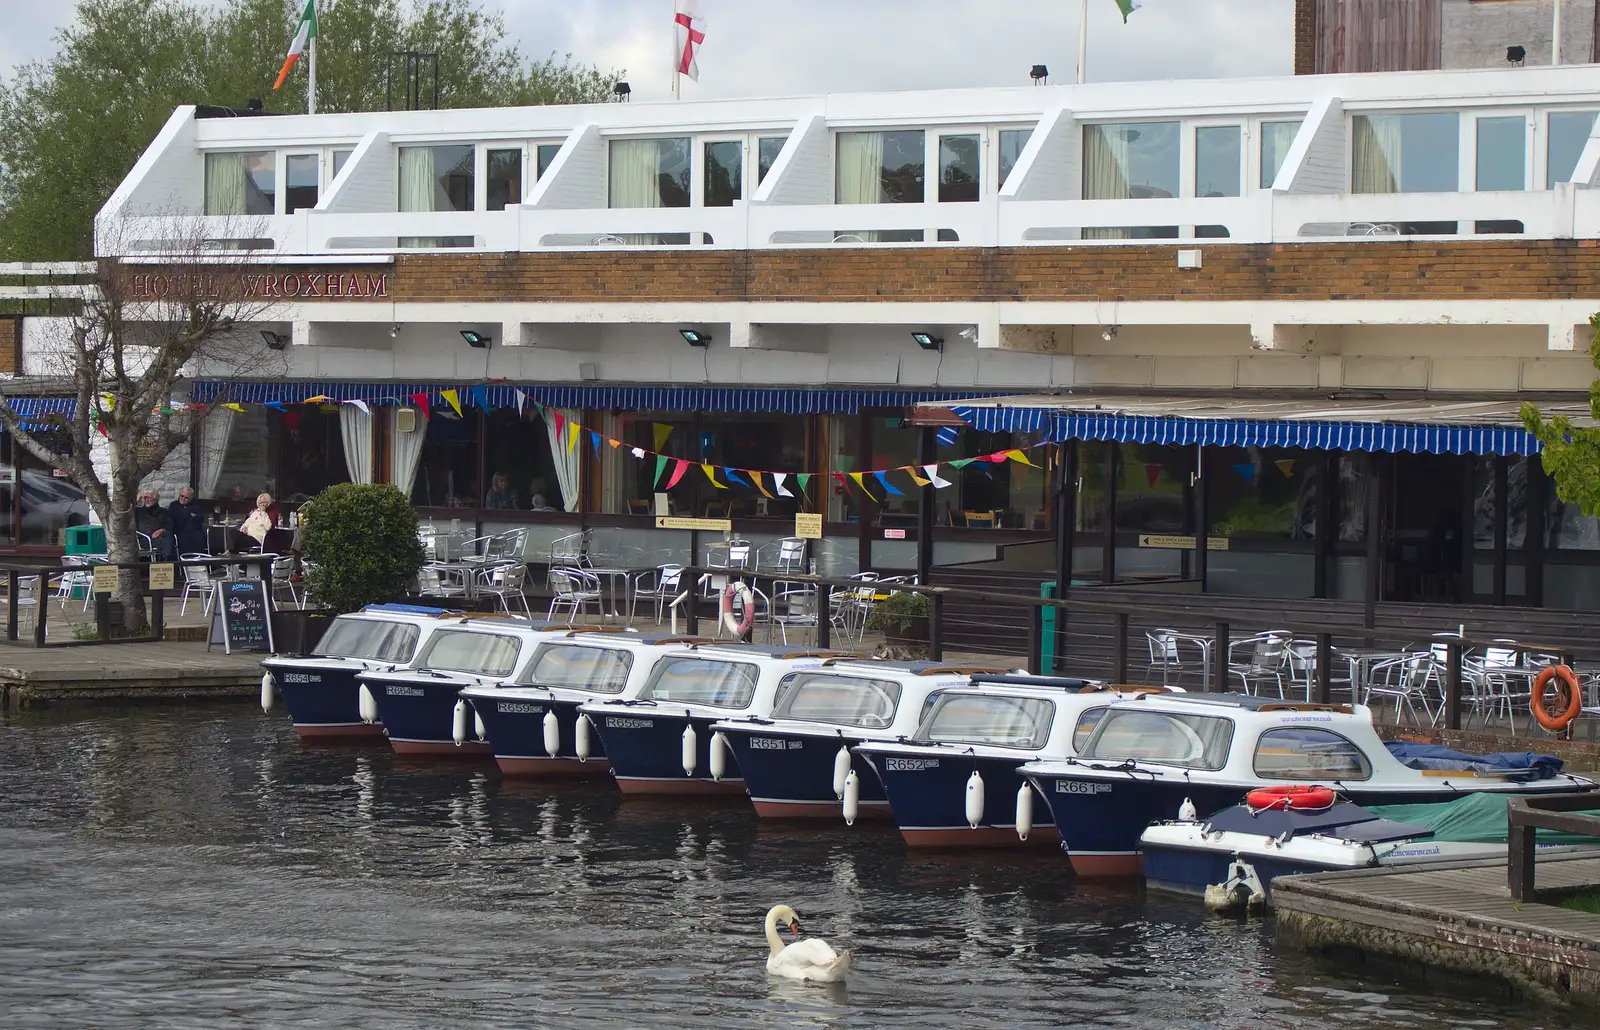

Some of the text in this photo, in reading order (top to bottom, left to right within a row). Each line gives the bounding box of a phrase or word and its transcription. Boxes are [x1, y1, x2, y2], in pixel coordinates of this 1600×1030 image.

[132, 272, 388, 298] HOTEL WROXHAM
[284, 673, 309, 683] R654
[386, 685, 412, 696] R664
[498, 702, 531, 713] R659
[606, 717, 641, 728] R656
[750, 737, 785, 749] R651
[886, 758, 925, 770] R652
[1057, 780, 1096, 794] R661
